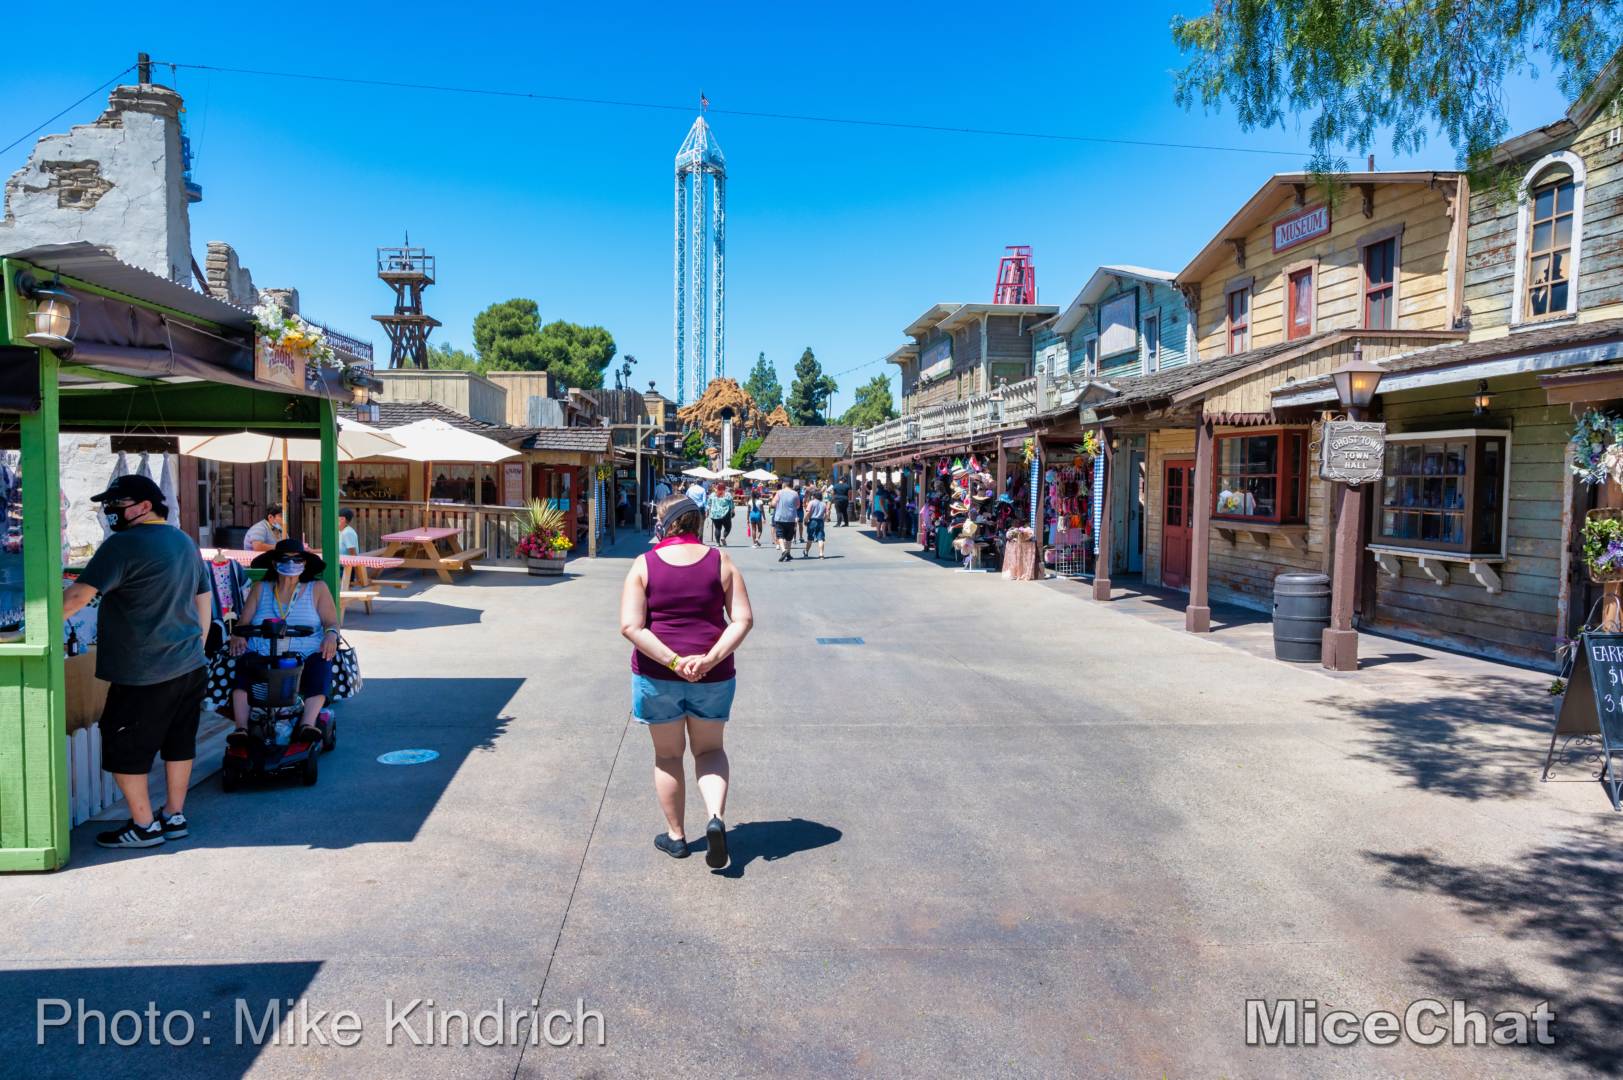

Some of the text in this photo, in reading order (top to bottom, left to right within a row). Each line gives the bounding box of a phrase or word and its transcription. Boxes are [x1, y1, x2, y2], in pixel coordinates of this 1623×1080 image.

[1280, 210, 1323, 244] MUSEUM
[1331, 435, 1383, 452] GHOST TOWN
[1343, 451, 1369, 460] TOWN
[1344, 461, 1368, 469] HALL
[1604, 694, 1615, 713] 3
